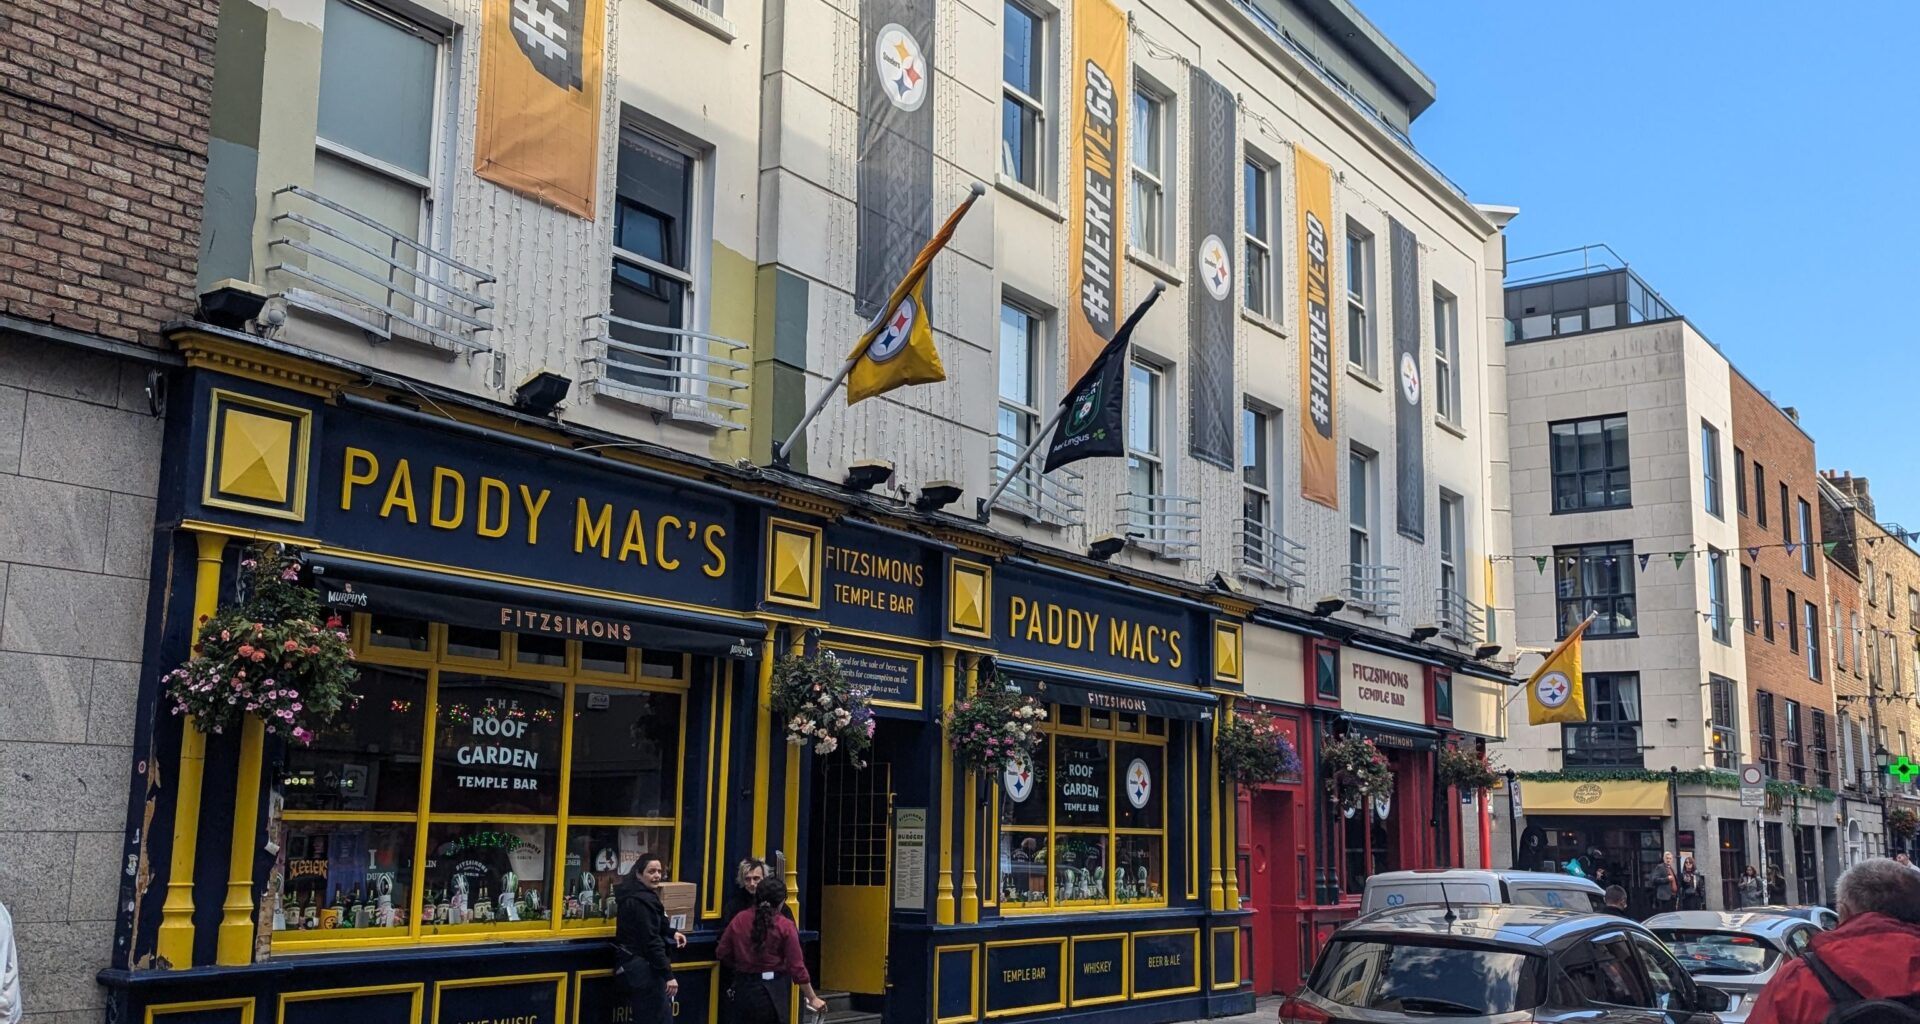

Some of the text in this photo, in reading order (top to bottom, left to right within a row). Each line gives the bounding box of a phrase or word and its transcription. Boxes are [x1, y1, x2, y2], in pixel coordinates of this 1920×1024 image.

[1082, 61, 1112, 324] #HEREWEGO
[1306, 211, 1329, 425] #HEREWEGO
[340, 446, 728, 578] PADDY MAC'S
[826, 545, 924, 588] FITZSIMONS
[834, 583, 914, 615] TEMPLE BAR
[501, 607, 632, 642] FITZSIMONS
[1009, 595, 1182, 669] PADDY MAC'S
[1352, 662, 1409, 689] FITZSIMONS
[485, 697, 519, 709] THE
[1088, 692, 1147, 712] FITZSIMONS
[1358, 685, 1405, 707] TEMPLE BAR
[472, 717, 529, 739] ROOF
[457, 746, 539, 770] GARDEN
[1074, 751, 1089, 759] THE
[1068, 763, 1094, 778] ROOF
[457, 775, 538, 790] TEMPLE BAR
[1063, 783, 1099, 798] GARDEN
[1064, 802, 1100, 812] TEMPLE BAR
[1083, 961, 1112, 974] WHISKEY
[1148, 955, 1164, 968] BEER
[1169, 954, 1181, 966] ALE
[1003, 966, 1046, 983] TEMPLE BAR
